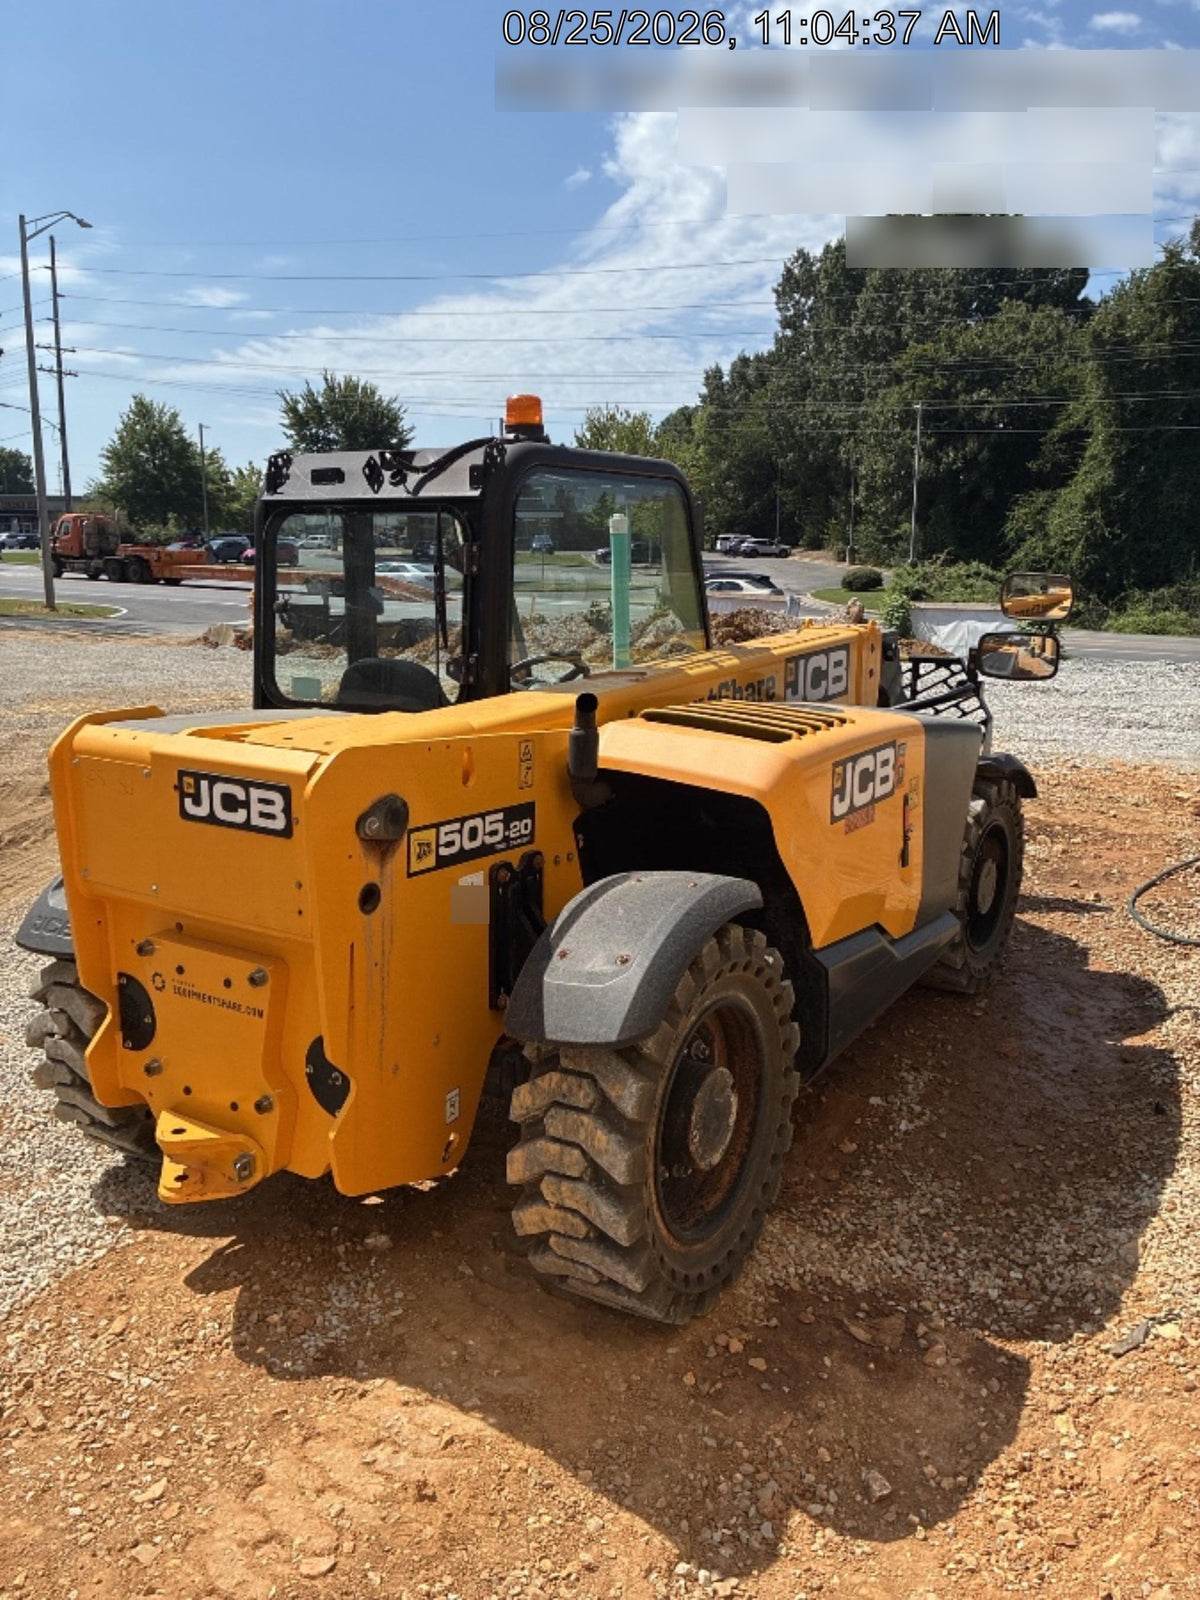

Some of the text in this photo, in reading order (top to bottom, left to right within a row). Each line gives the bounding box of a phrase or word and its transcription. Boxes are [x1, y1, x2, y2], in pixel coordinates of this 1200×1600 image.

[785, 650, 848, 702] JCB
[184, 780, 287, 831] JCB
[833, 746, 896, 817] JCB
